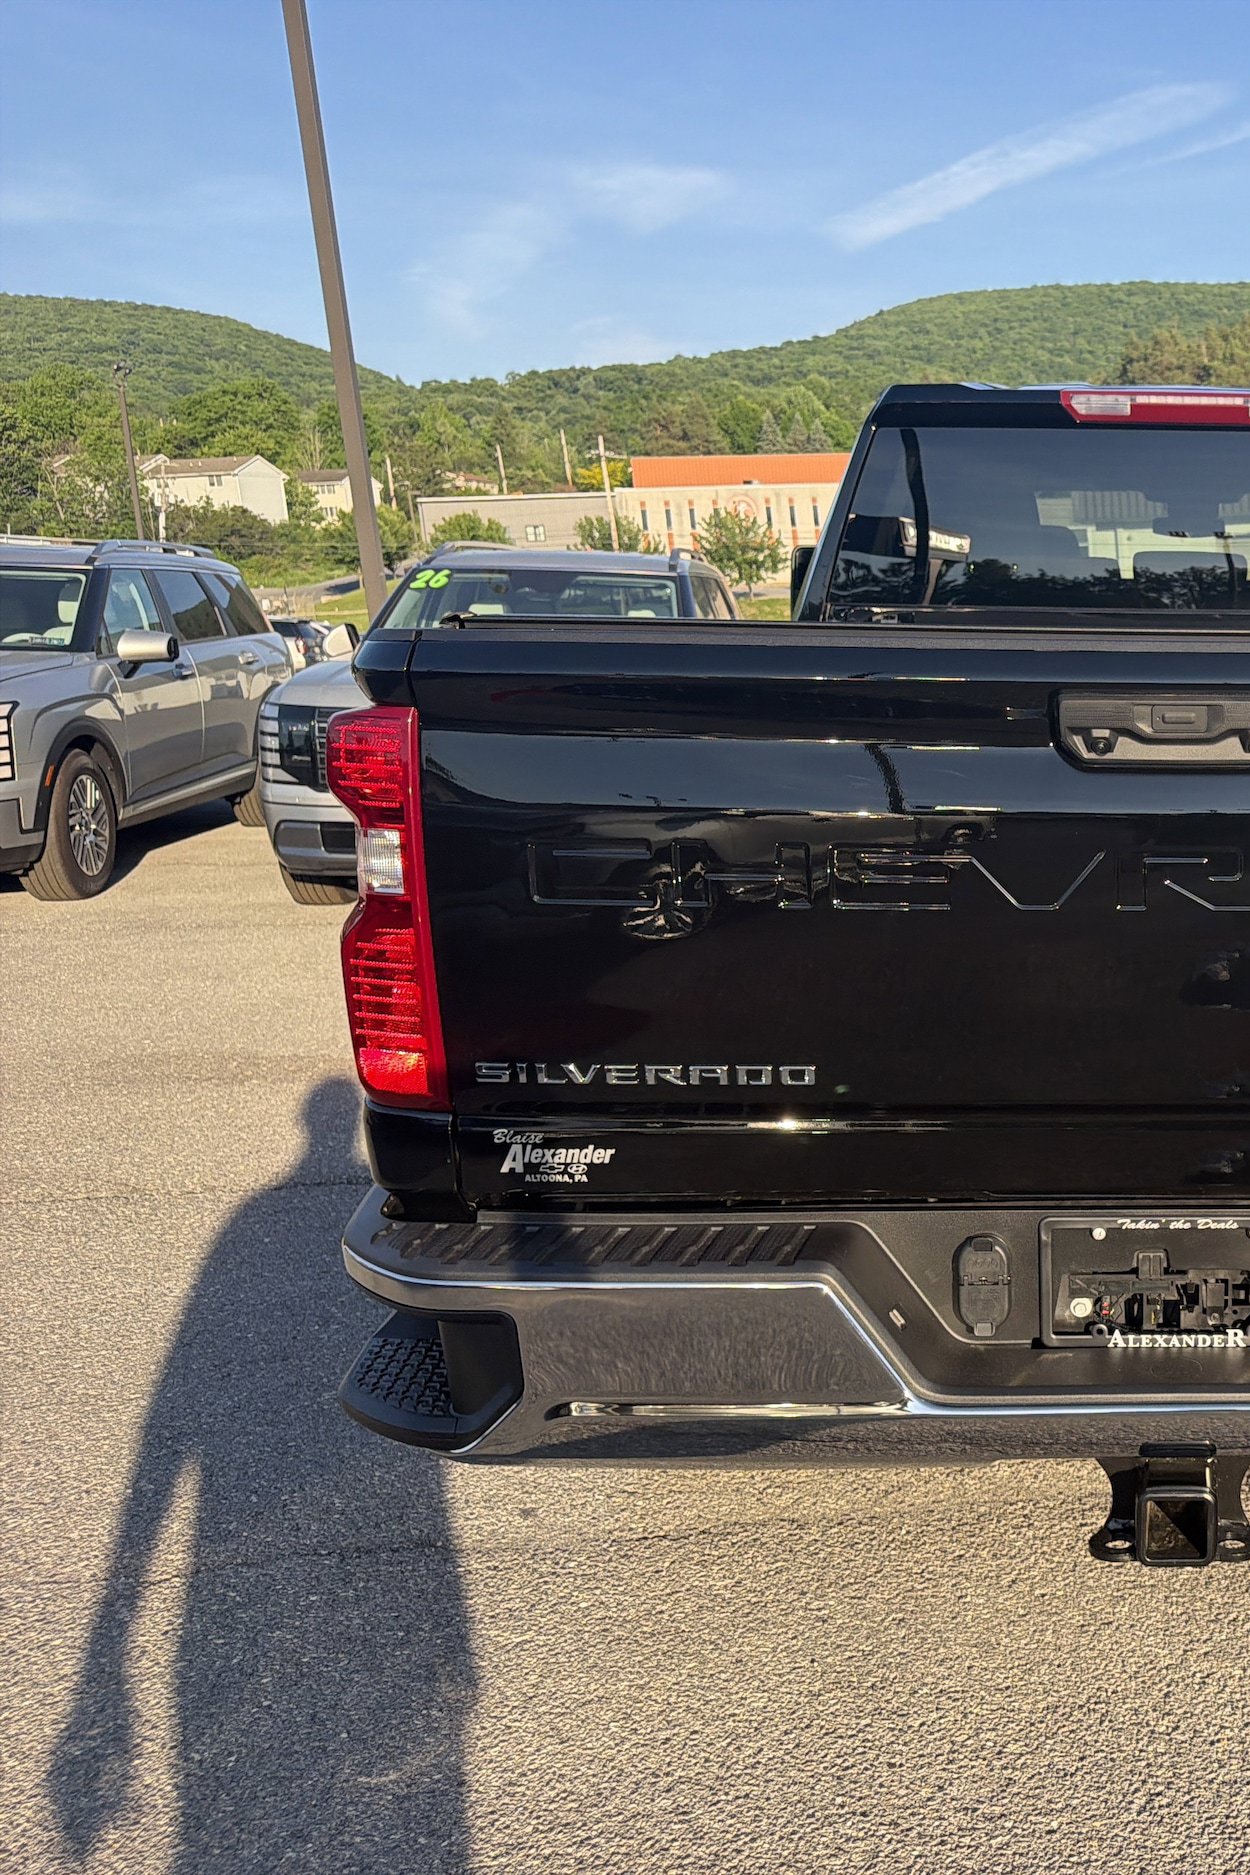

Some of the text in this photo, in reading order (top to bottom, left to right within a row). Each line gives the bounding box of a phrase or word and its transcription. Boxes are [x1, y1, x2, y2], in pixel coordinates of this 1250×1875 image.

[410, 569, 452, 589] 26
[474, 1061, 817, 1086] SILVERADO
[492, 1128, 545, 1144] Blaise
[499, 1143, 616, 1173] Alexander
[524, 1174, 588, 1183] ALTOONA, PA
[1116, 1219, 1239, 1230] Takin' the Deals
[1107, 1328, 1247, 1348] ALEXANDER
